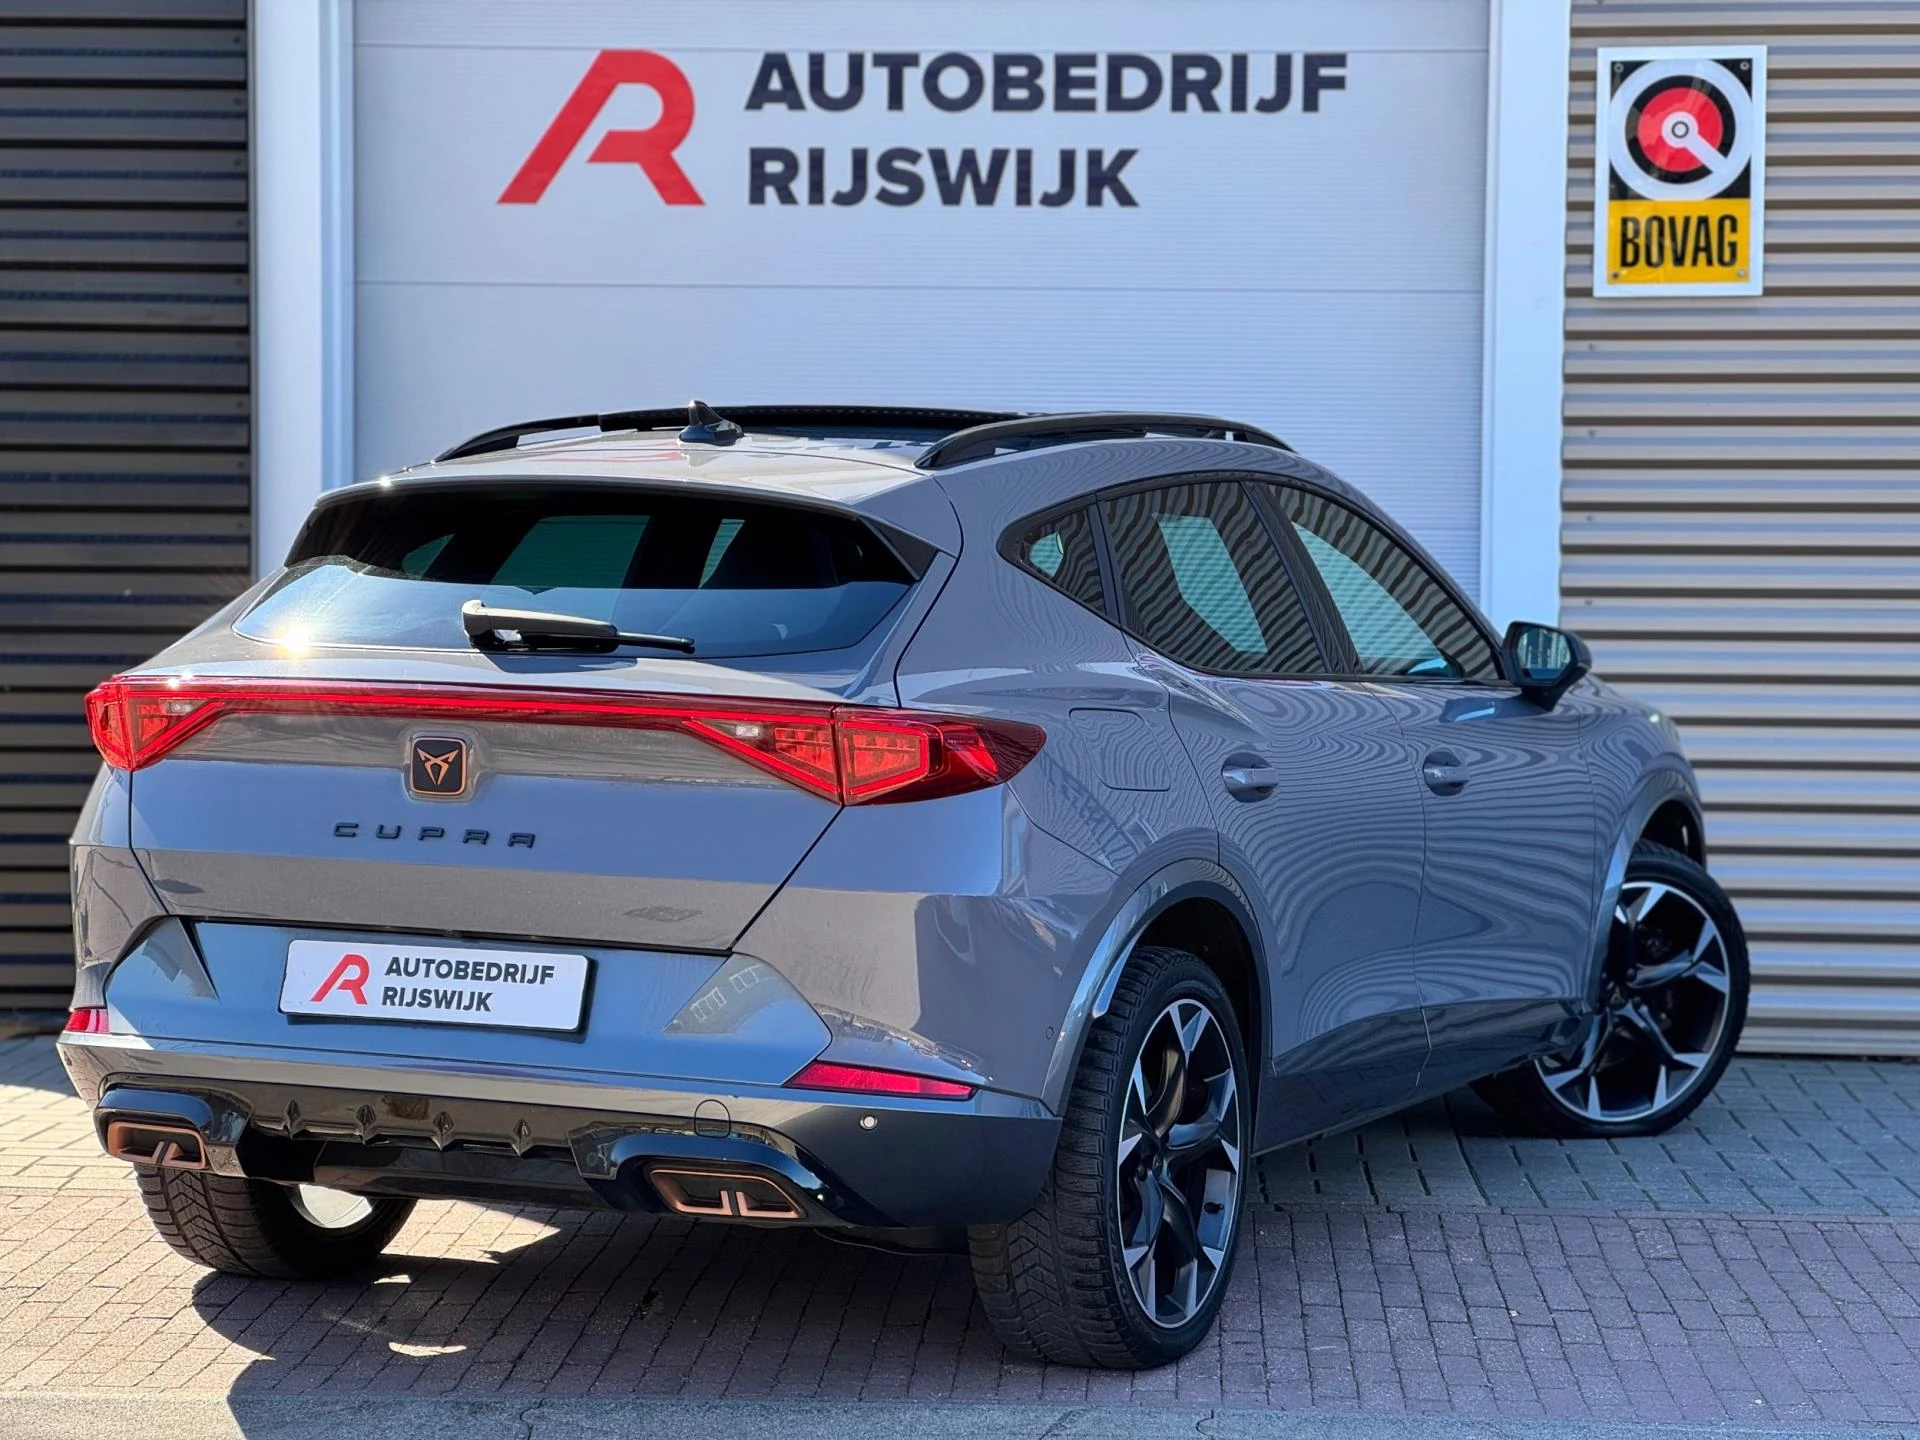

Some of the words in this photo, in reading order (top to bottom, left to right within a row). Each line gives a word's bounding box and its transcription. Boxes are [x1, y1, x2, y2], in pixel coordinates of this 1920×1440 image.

[746, 52, 1347, 114] AUTOBEDRIJF
[749, 147, 1139, 208] RIJSWIJK
[1620, 214, 1738, 268] BOVAG
[333, 822, 536, 849] CUPRA
[384, 956, 555, 985] AUTOBEDRIJF
[381, 986, 493, 1013] RIJSWIJK
